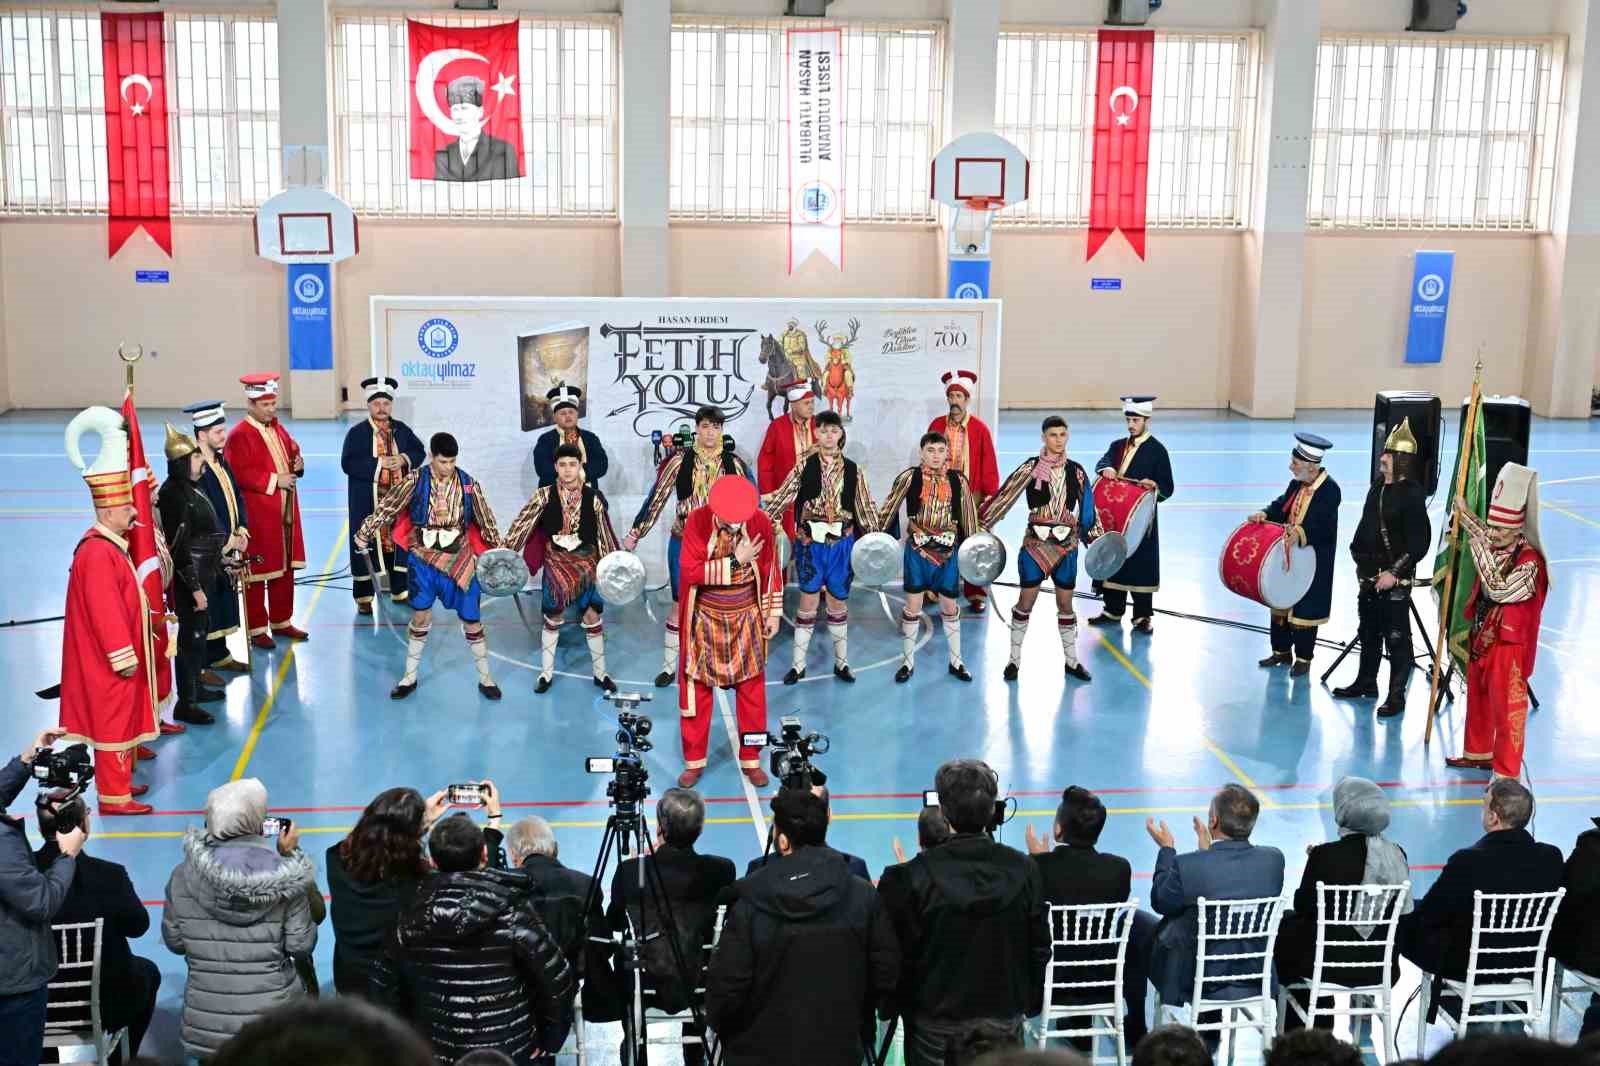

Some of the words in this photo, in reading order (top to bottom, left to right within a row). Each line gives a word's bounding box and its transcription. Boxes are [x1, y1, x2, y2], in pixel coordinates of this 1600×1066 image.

[799, 49, 812, 96] HASAN
[815, 50, 831, 93] LİSESİ
[799, 100, 813, 164] ULUBATLI
[818, 98, 832, 161] ANADOLU
[659, 316, 692, 324] HASAN
[694, 316, 728, 324] ERDEM
[934, 331, 968, 347] 700
[606, 321, 751, 384] FETİH
[621, 373, 735, 413] YOLU
